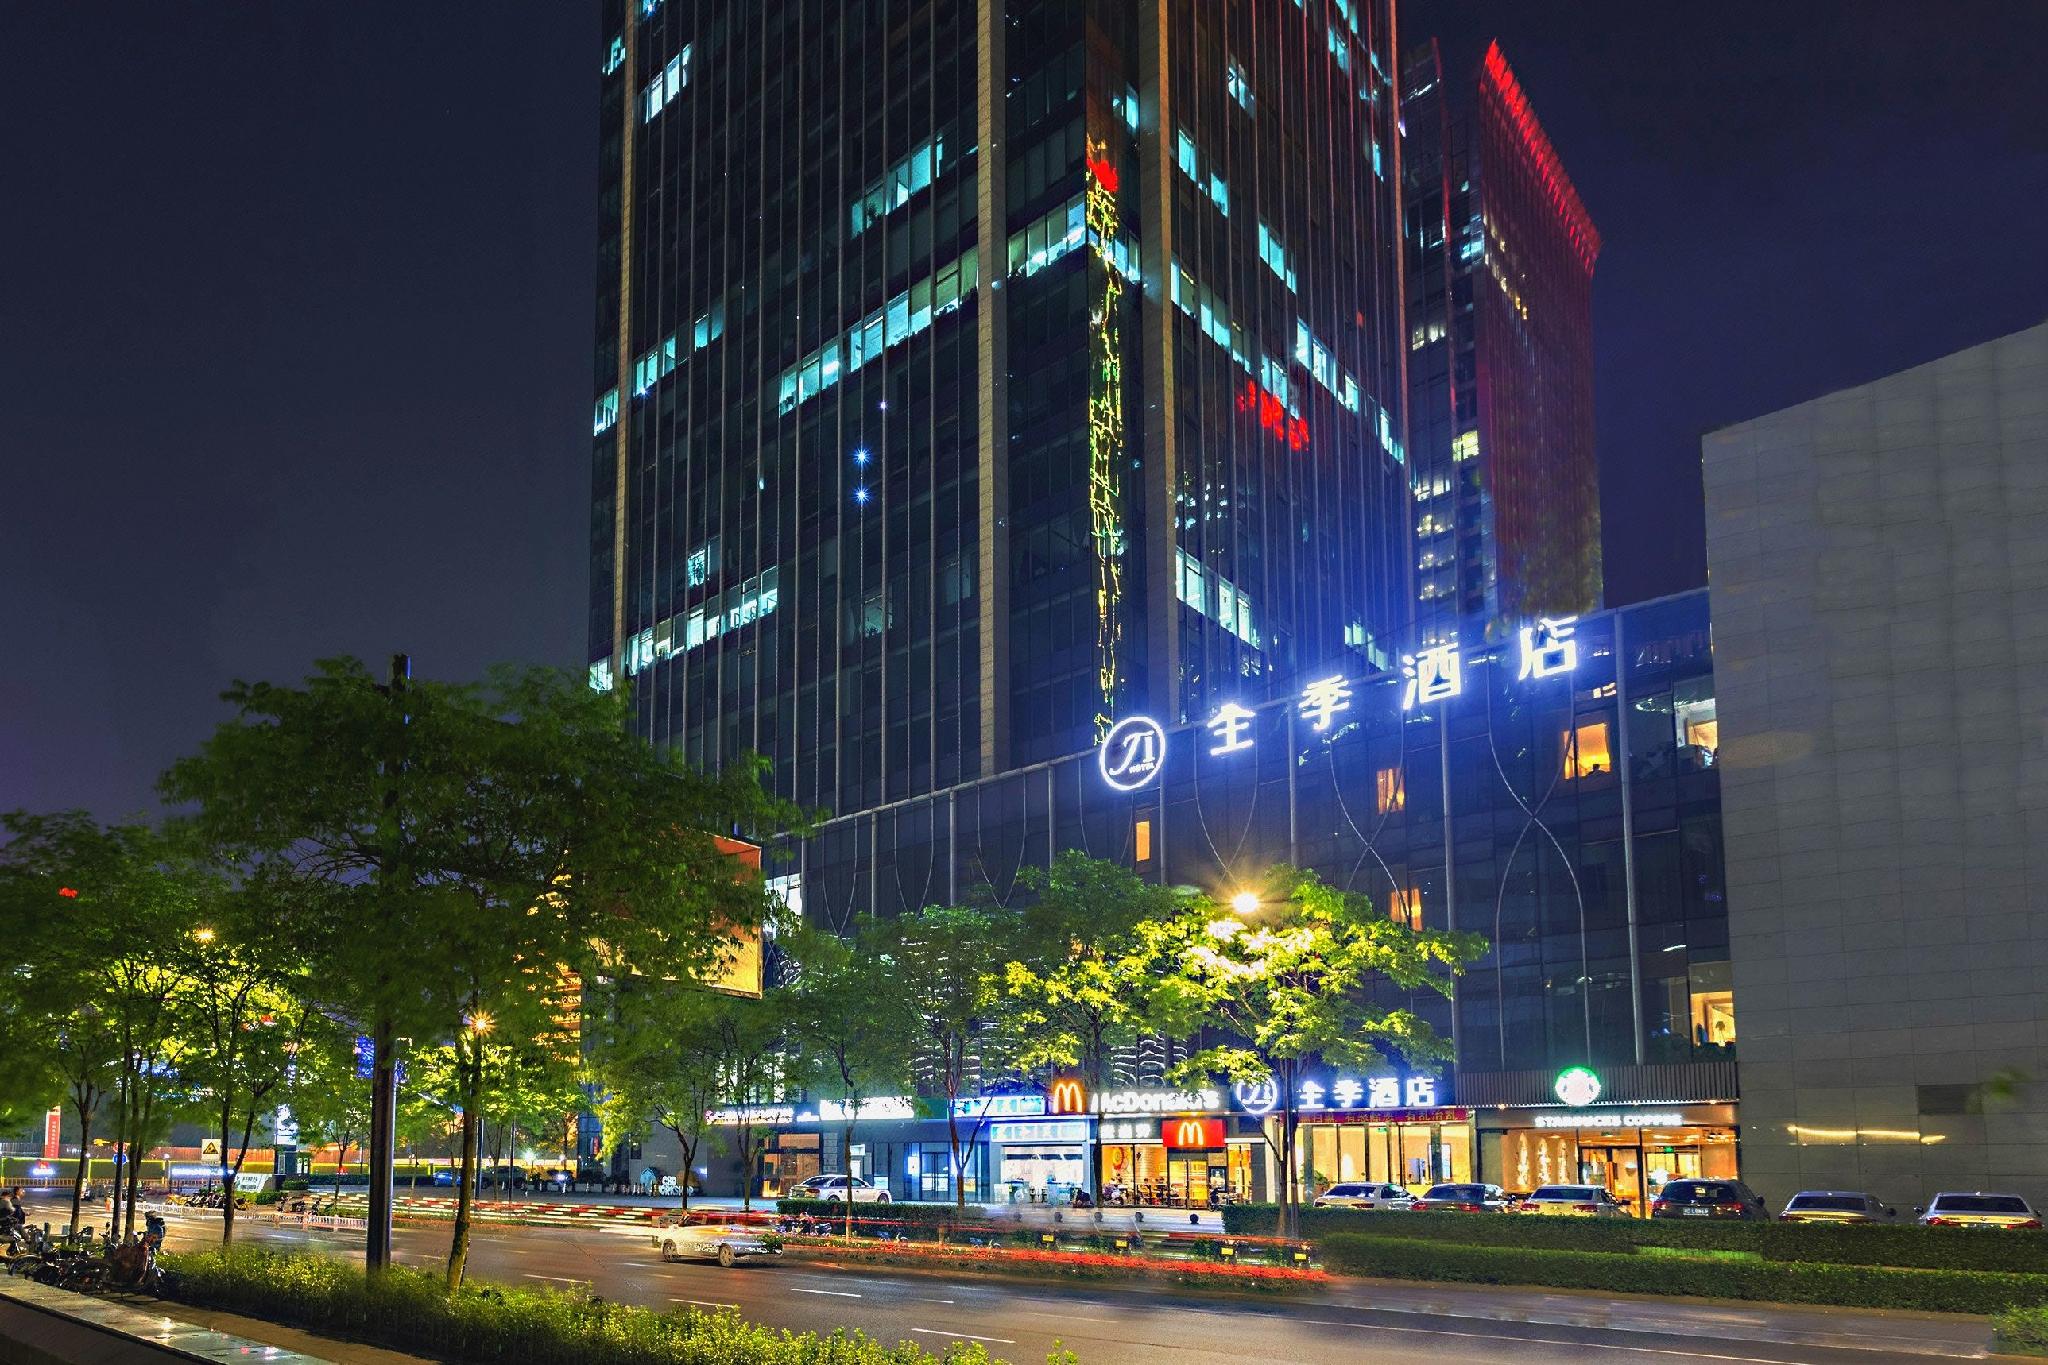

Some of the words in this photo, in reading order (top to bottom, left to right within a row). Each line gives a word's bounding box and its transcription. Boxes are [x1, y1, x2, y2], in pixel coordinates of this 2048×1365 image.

[1207, 615, 1578, 756] 全季酒店
[1297, 1076, 1436, 1109] 全季酒店
